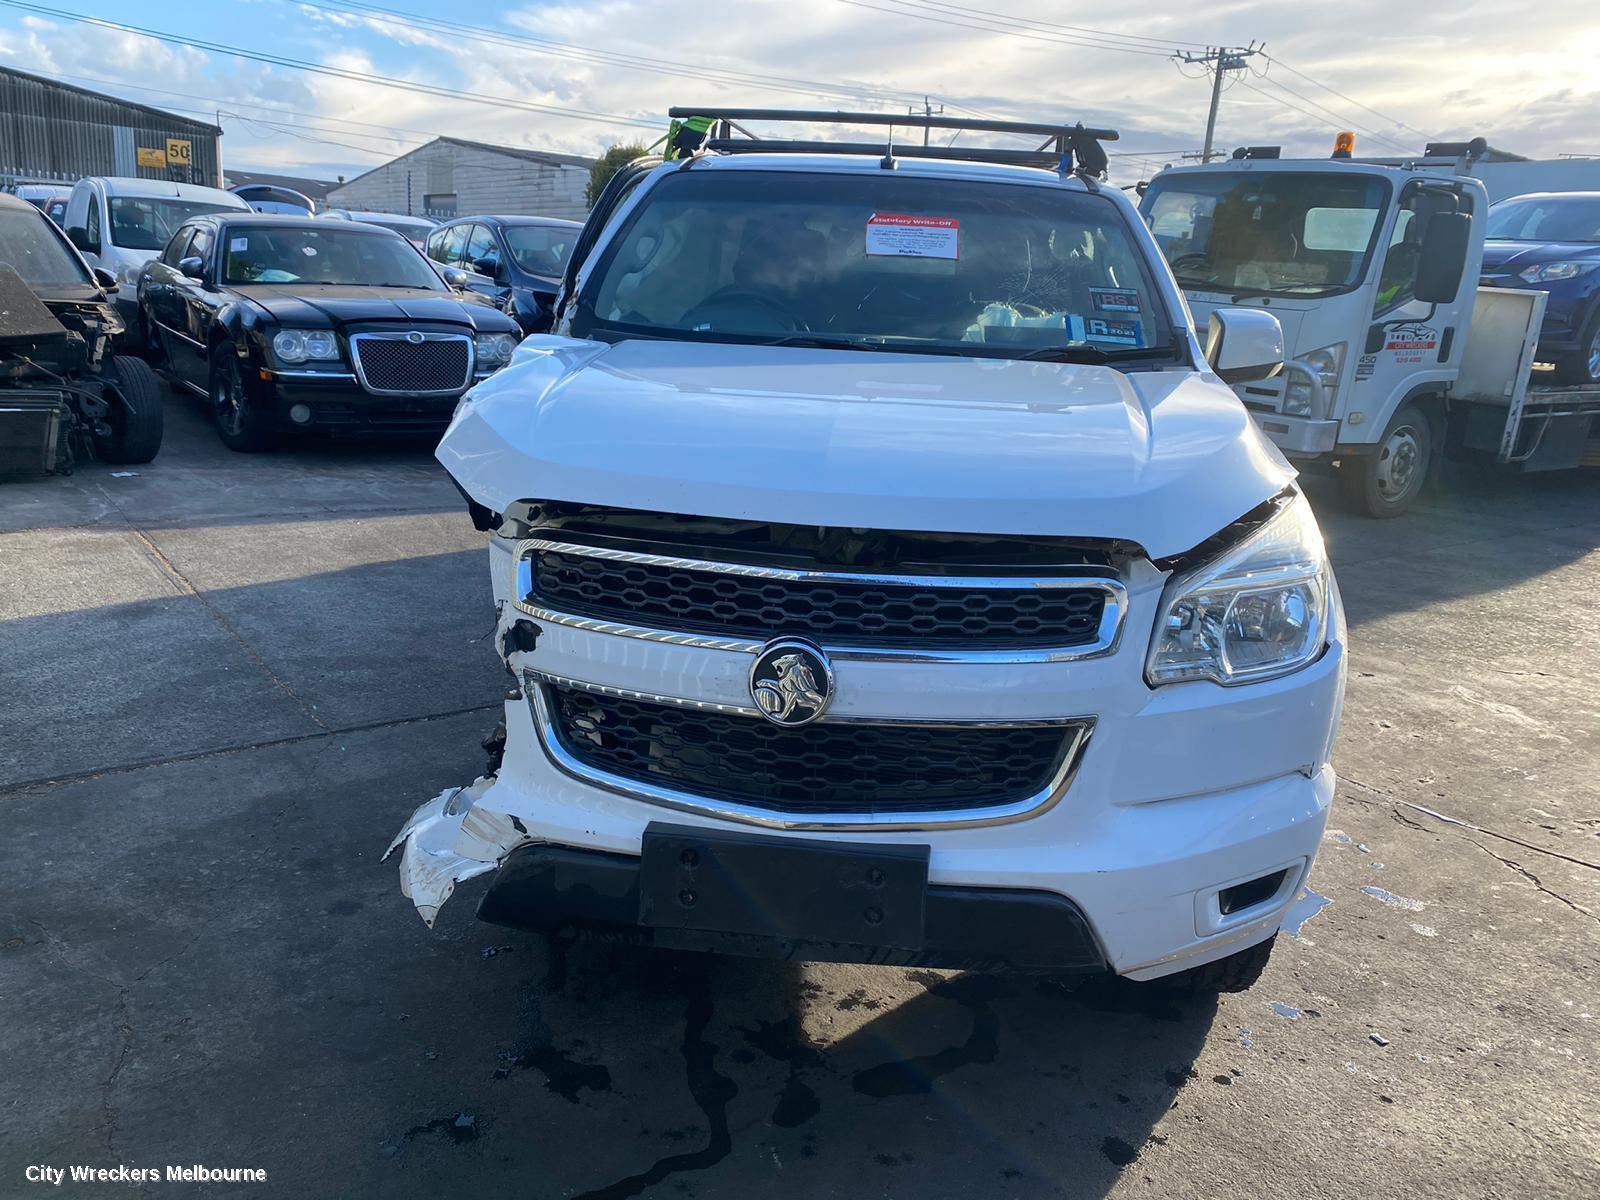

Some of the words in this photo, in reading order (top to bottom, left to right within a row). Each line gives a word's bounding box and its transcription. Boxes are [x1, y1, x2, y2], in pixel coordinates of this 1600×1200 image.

[169, 144, 189, 159] 50
[873, 217, 911, 225] Statutory
[1359, 355, 1377, 364] 450
